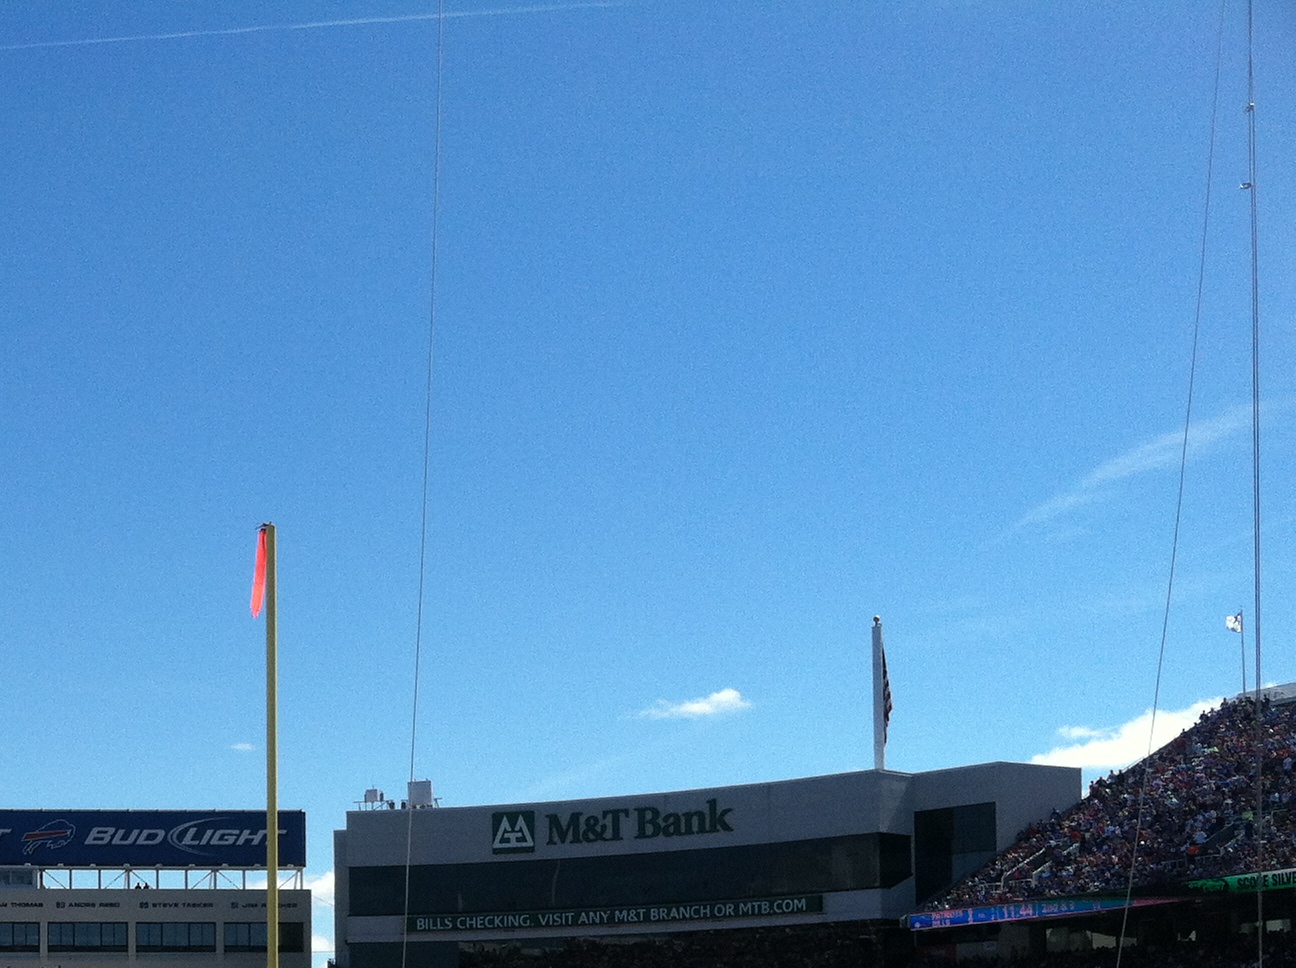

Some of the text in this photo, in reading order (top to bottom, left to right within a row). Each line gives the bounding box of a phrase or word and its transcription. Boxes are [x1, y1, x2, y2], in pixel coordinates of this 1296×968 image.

[545, 799, 734, 846] M&T Bank
[1237, 874, 1269, 890] SCOE
[416, 917, 452, 931] BILLS
[538, 912, 575, 926] VISIT
[578, 910, 611, 925] ANY
[615, 908, 647, 923] M&T
[650, 905, 710, 921] BRANCH
[714, 903, 734, 917] OR
[739, 898, 806, 915] MTB.COM
